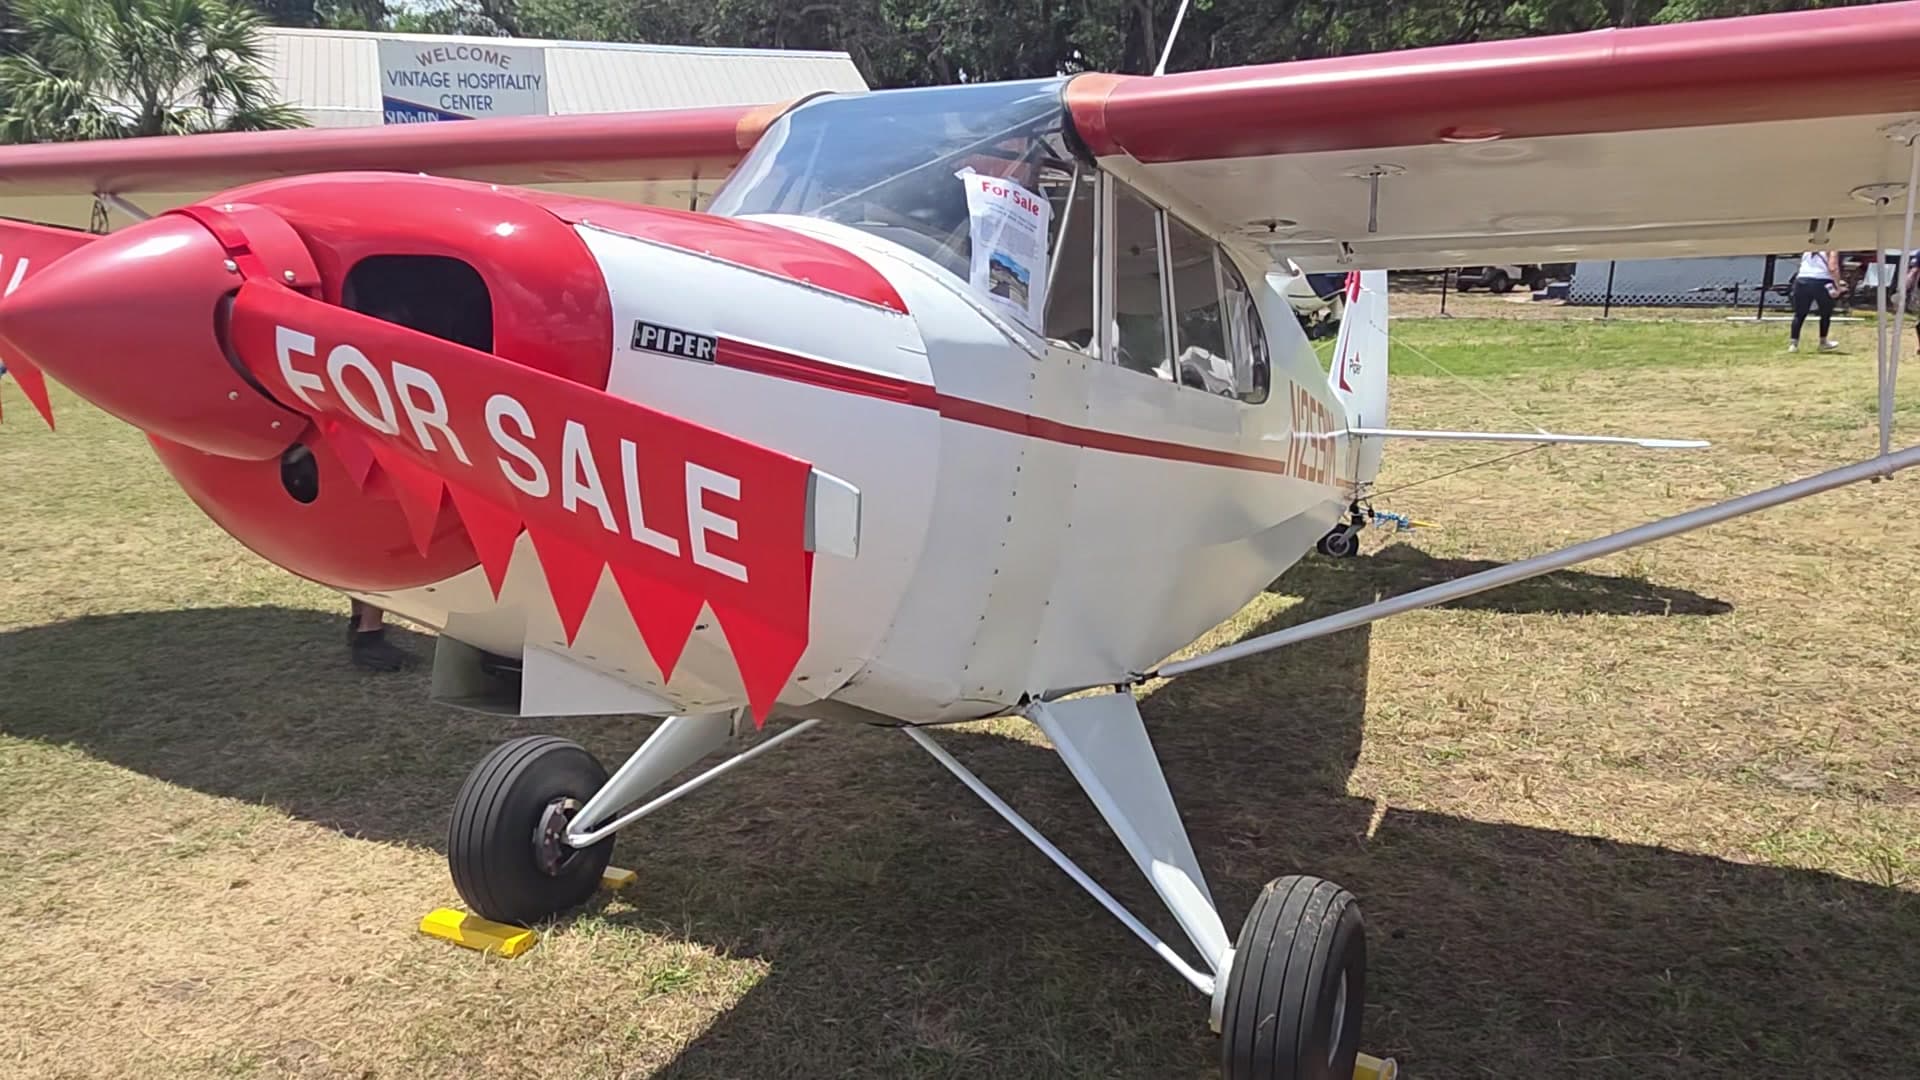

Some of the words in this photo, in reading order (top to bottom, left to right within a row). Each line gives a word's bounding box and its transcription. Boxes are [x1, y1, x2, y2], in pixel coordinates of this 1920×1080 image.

[416, 46, 511, 70] WELCOME
[387, 70, 450, 88] VINTAGE
[457, 73, 541, 90] HOSPITALITY
[439, 94, 493, 110] CENTER
[982, 181, 1009, 198] For
[1013, 190, 1040, 216] Sale
[640, 325, 712, 359] PIPER
[276, 325, 473, 466] FOR
[484, 394, 748, 584] SALE
